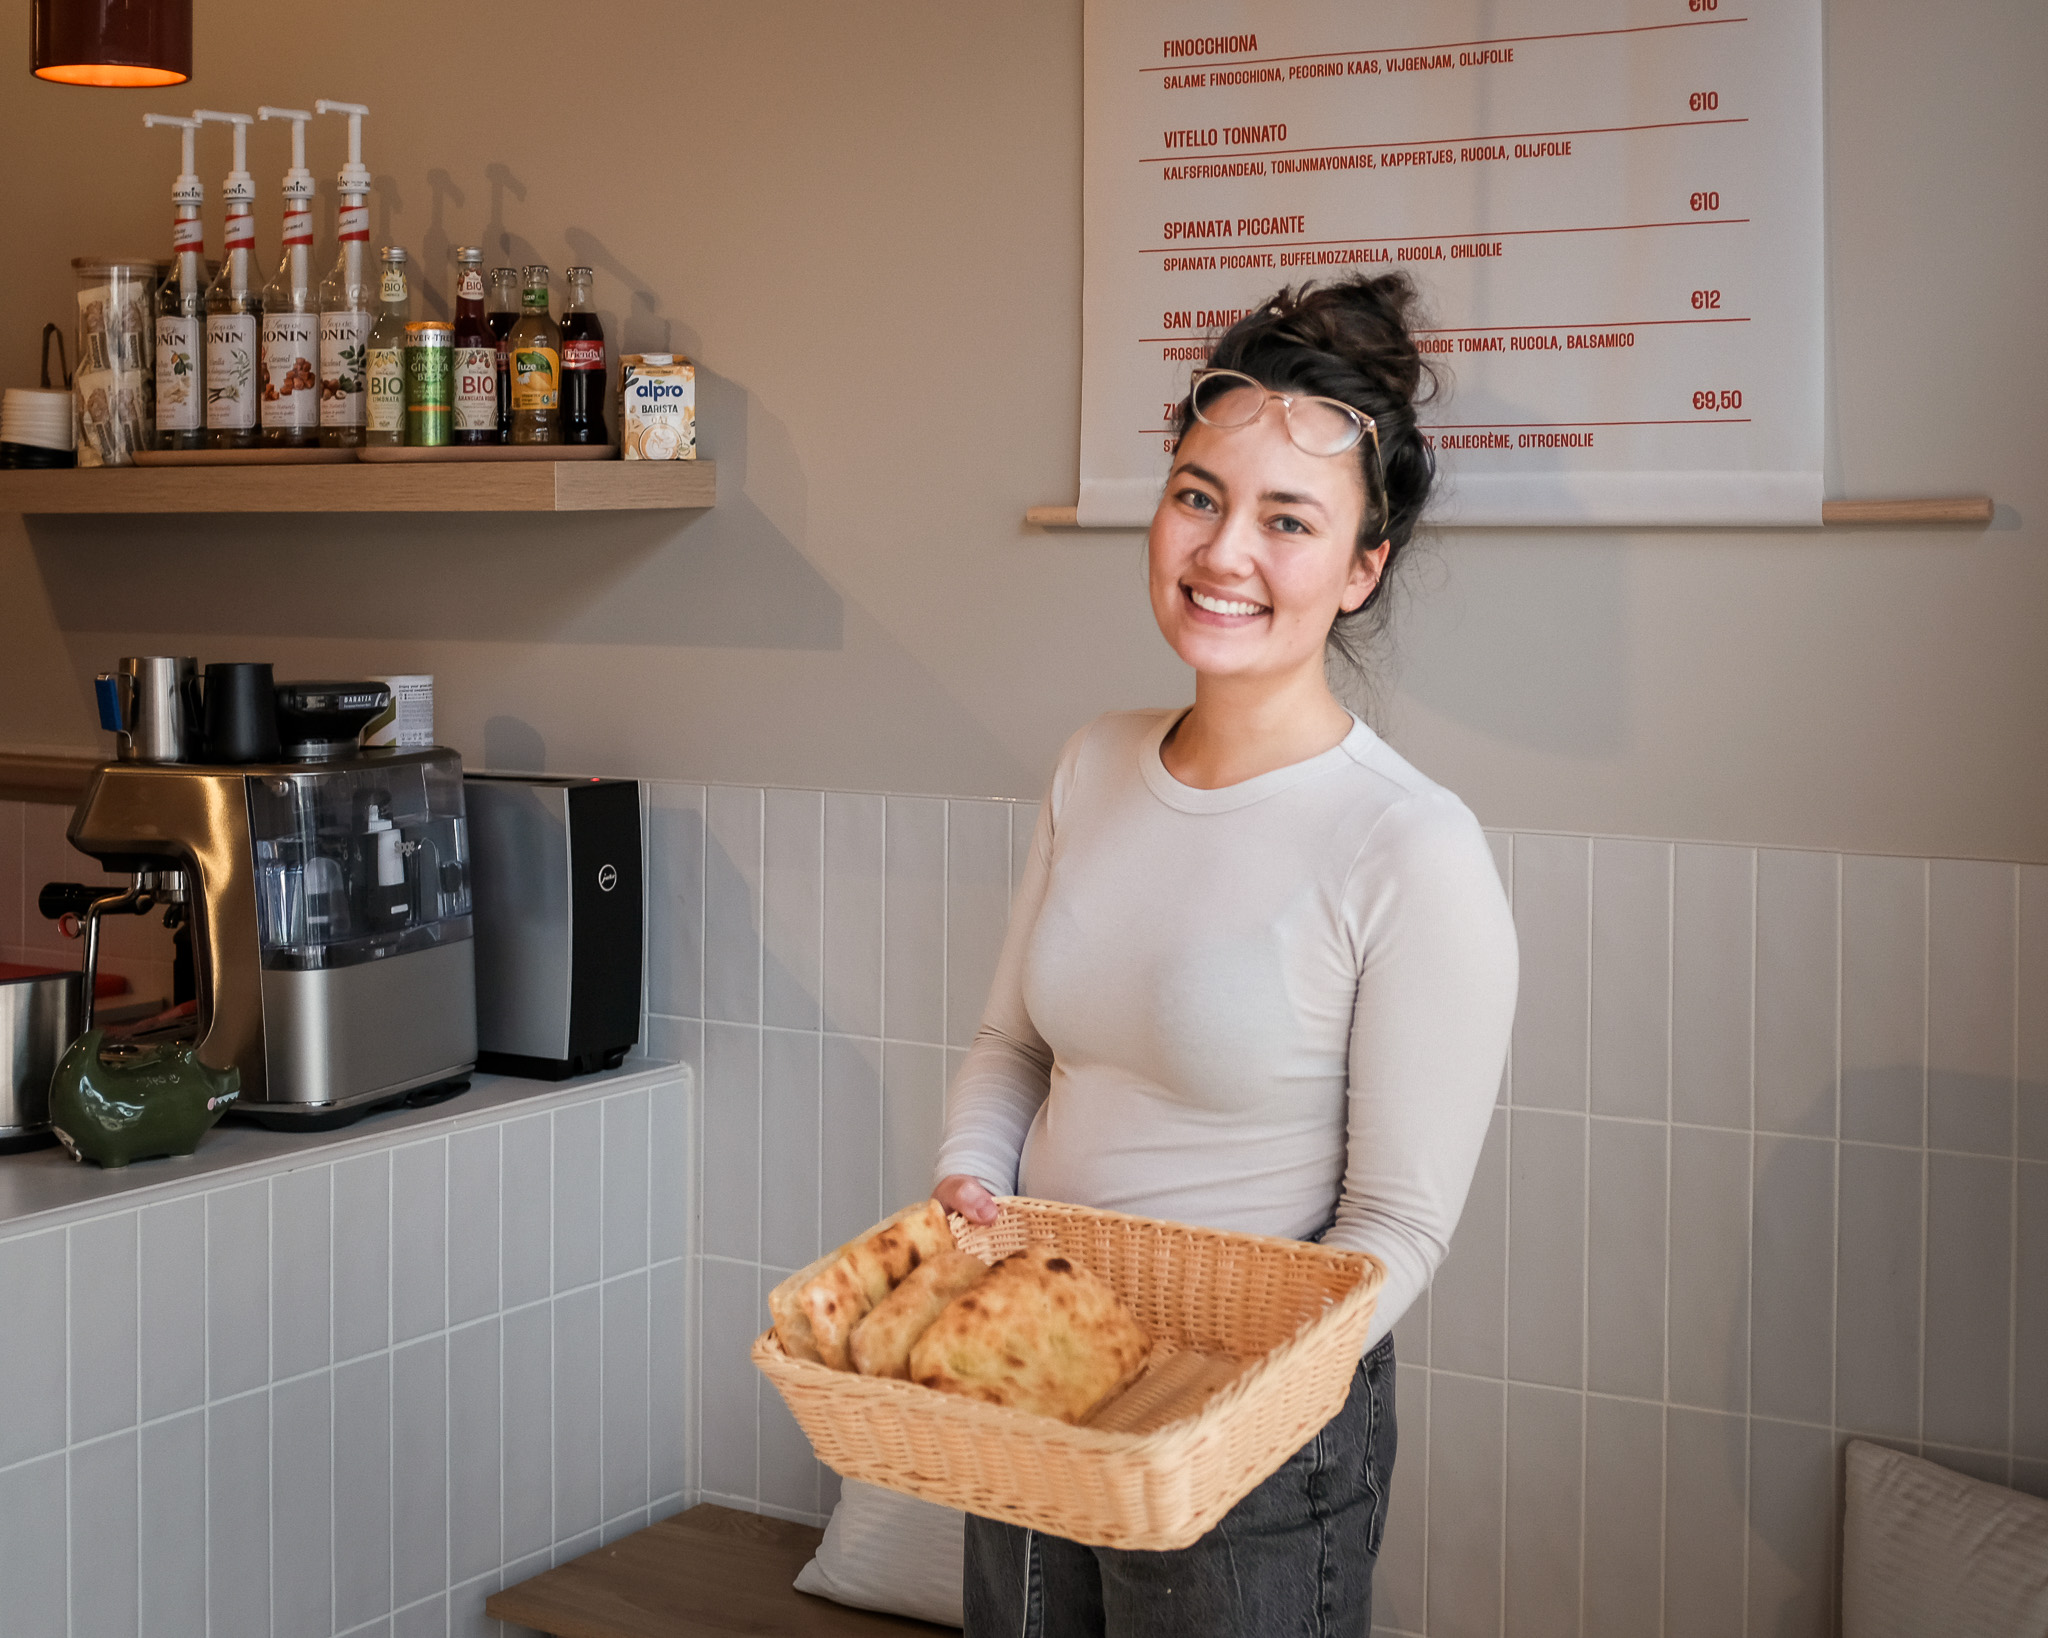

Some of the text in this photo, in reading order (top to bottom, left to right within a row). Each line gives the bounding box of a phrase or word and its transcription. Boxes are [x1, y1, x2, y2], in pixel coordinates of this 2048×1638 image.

[1163, 34, 1258, 58] FINOCCHIONA
[1163, 48, 1514, 89] SALAME FINOCCHIONA, PECORINO KAAS, VIJGENJAM, OLIJFOLIE
[1688, 91, 1719, 112] €10
[1163, 123, 1288, 149] VITELLO TONNATO
[1163, 141, 1572, 181] KALFSFRICANDEAU, TONIJNMAYONAISE, KAPPERTJES, RUCOLA, OLIJFOLIE
[283, 181, 306, 192] ONIN
[1689, 191, 1720, 212] €10
[1163, 215, 1305, 241] SPIANATA PICCANTE
[1163, 242, 1503, 272] SPIANATA PICCANTE, BUFFELMOZZARELLA, RUCOLA, CHILIOLIE
[384, 282, 401, 292] BIO
[466, 281, 482, 291] BIO
[1690, 290, 1721, 310] €12
[1163, 309, 1253, 330] SAN DANIE
[157, 334, 186, 346] NIN
[207, 332, 243, 344] ONIN
[321, 329, 359, 341] ONIN
[1415, 338, 1454, 354] OOGDE
[1457, 336, 1506, 353] TOMAAT,
[1510, 335, 1562, 352] RUCOLA,
[1566, 332, 1635, 350] BALSAMICO
[411, 363, 449, 372] GINGER
[517, 362, 536, 371] fuze
[371, 377, 403, 395] BIO
[417, 372, 442, 382] BEER
[463, 376, 494, 394] BIO
[636, 379, 684, 402] alpro
[641, 404, 678, 414] BARISTA
[1692, 389, 1743, 412] €9,50
[1441, 432, 1514, 450] SALIECRÈME,
[1518, 432, 1594, 449] CITROENOLIE
